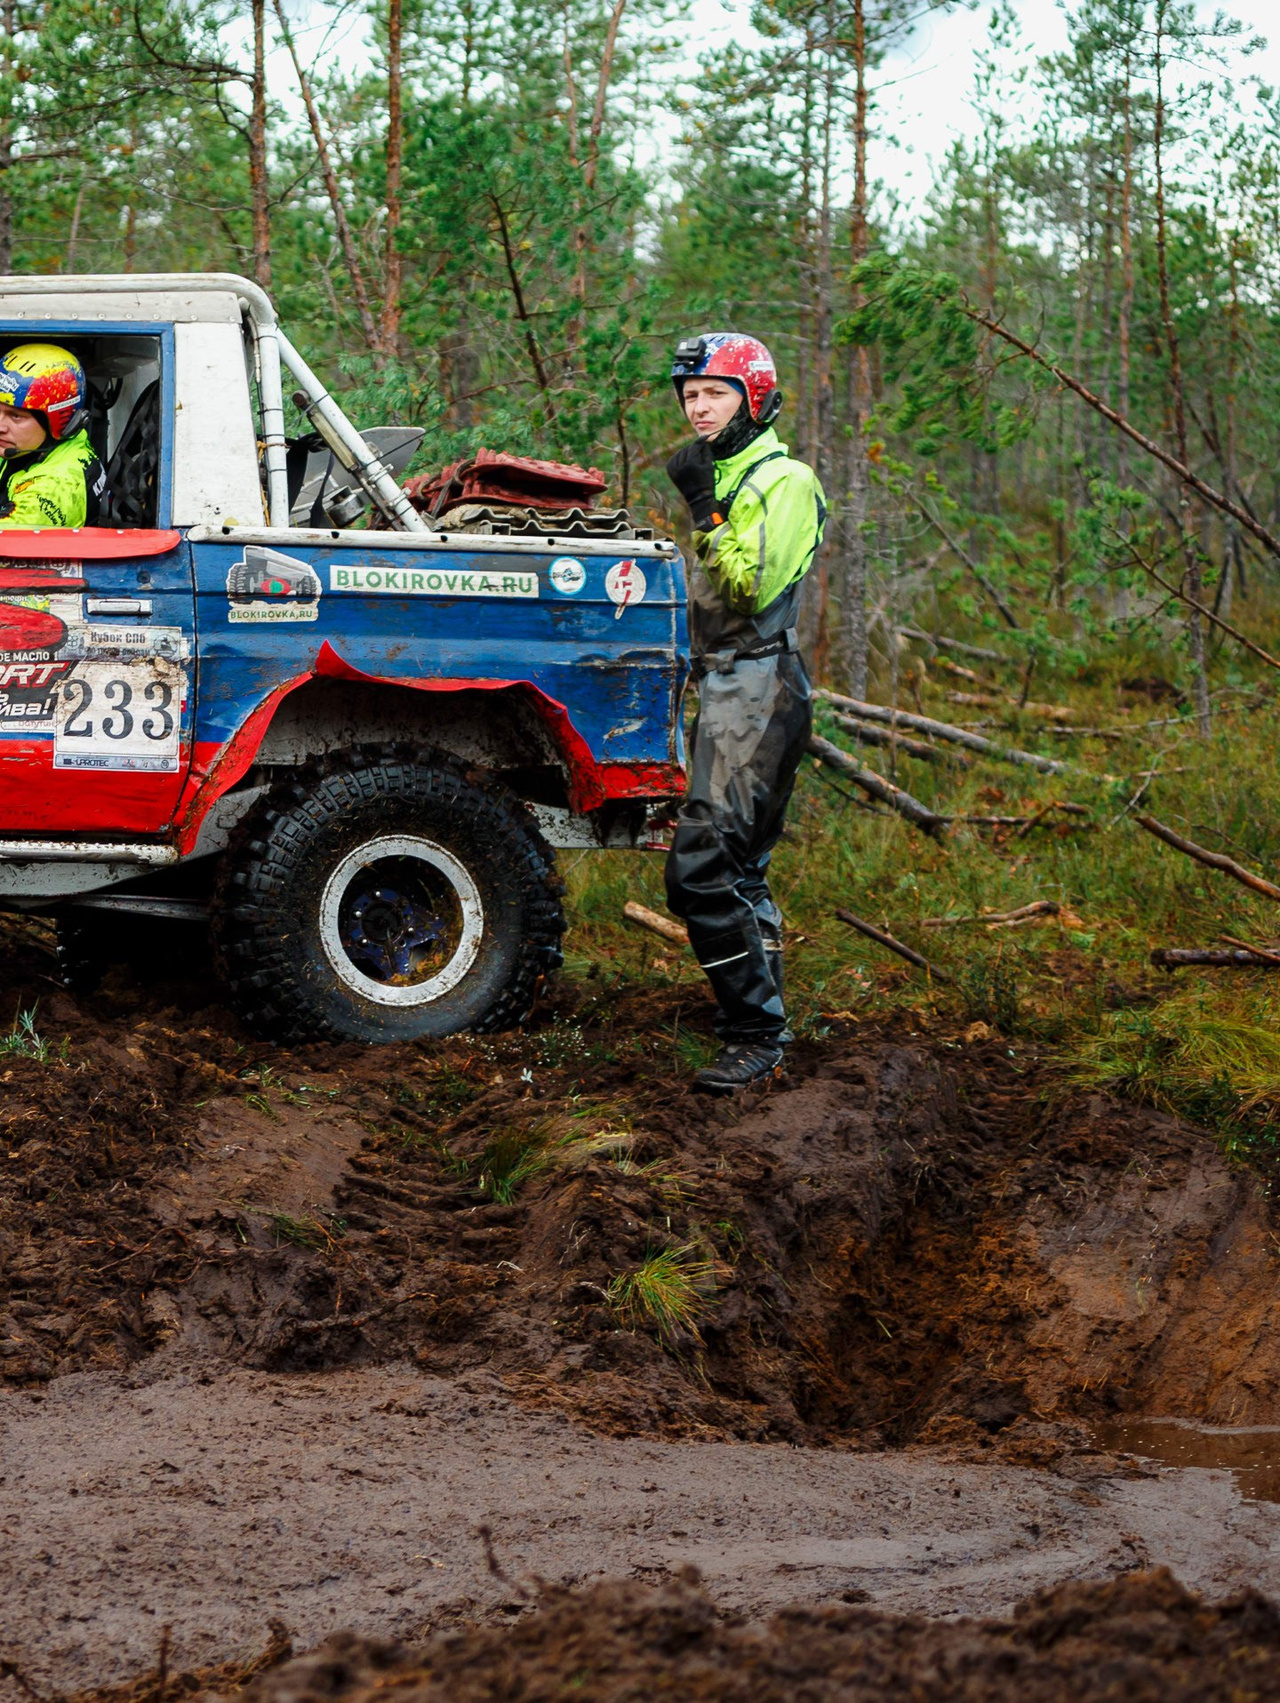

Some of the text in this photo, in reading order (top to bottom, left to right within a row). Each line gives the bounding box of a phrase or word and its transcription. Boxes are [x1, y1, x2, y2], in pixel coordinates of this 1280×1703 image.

[336, 569, 533, 594] BLOKIROVKA.RU
[230, 610, 313, 620] BLOKIROVKA.RU
[90, 631, 146, 644] Кубок СПб
[12, 651, 50, 662] МАСЛО
[63, 679, 174, 741] 233
